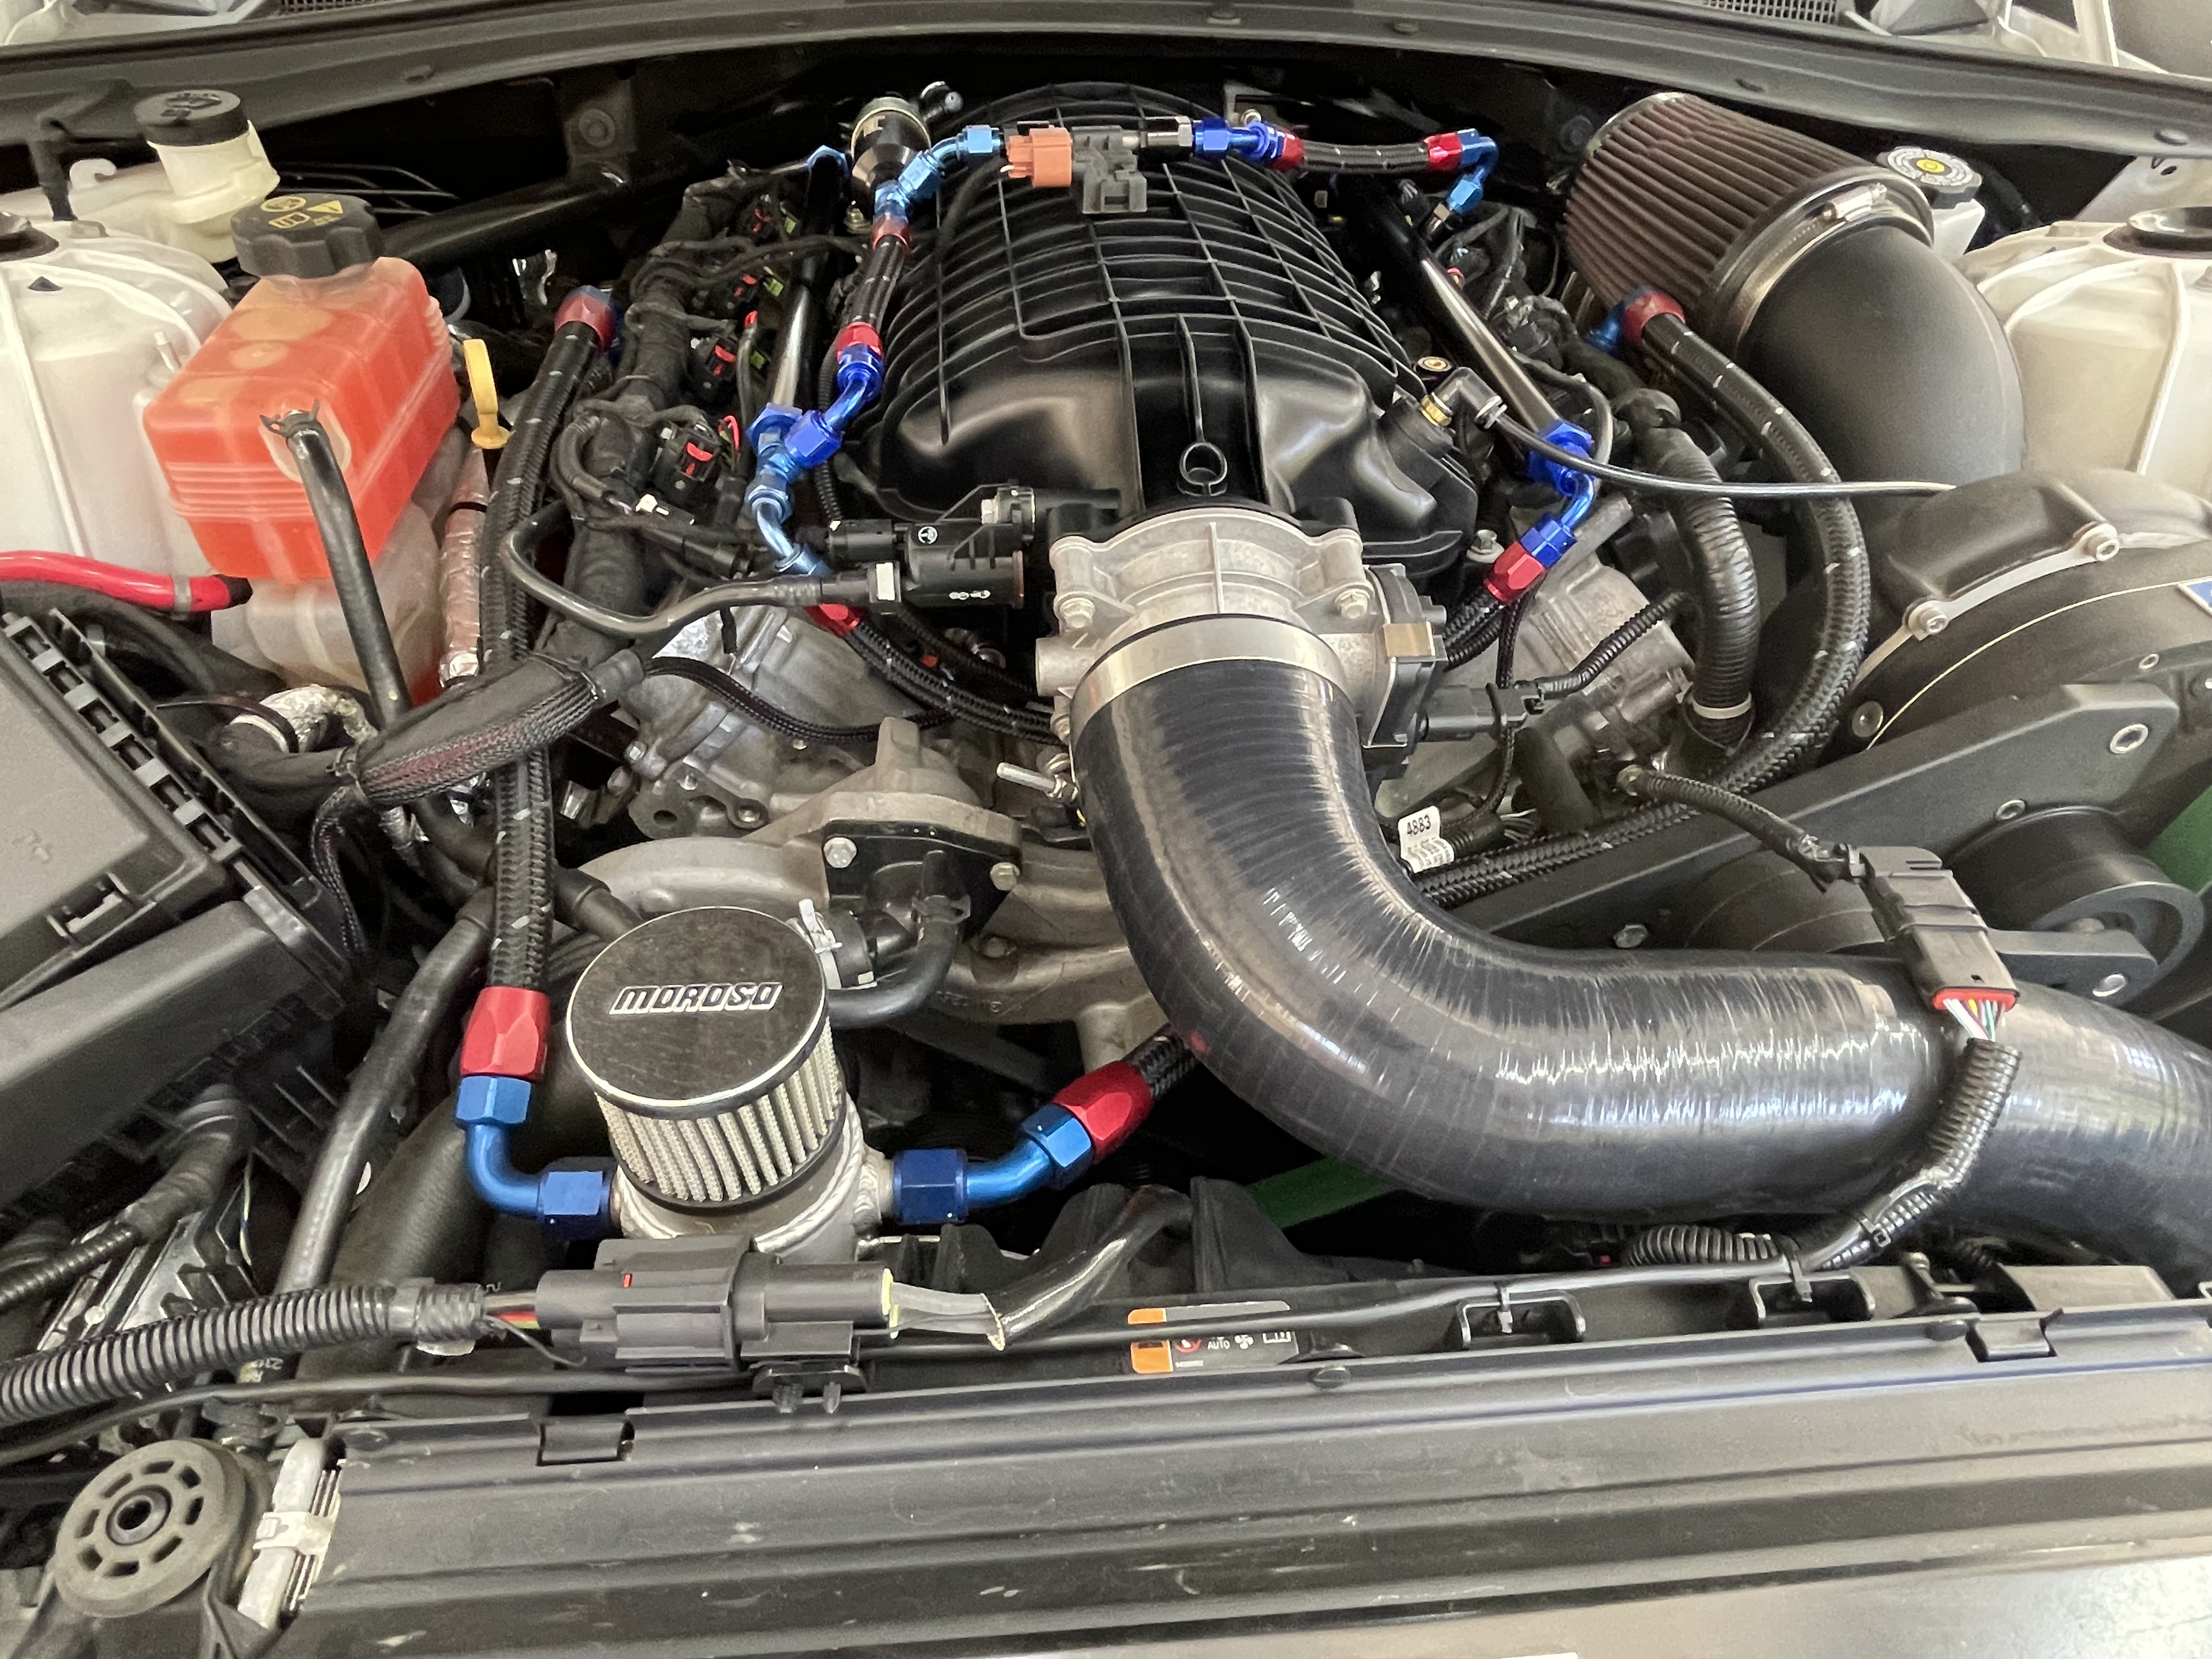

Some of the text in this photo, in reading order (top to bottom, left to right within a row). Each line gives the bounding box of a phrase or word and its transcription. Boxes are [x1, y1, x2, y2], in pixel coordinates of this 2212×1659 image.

[1407, 815, 1431, 837] 4883
[609, 982, 783, 1015] MOROSO
[1207, 1340, 1231, 1350] AUTO
